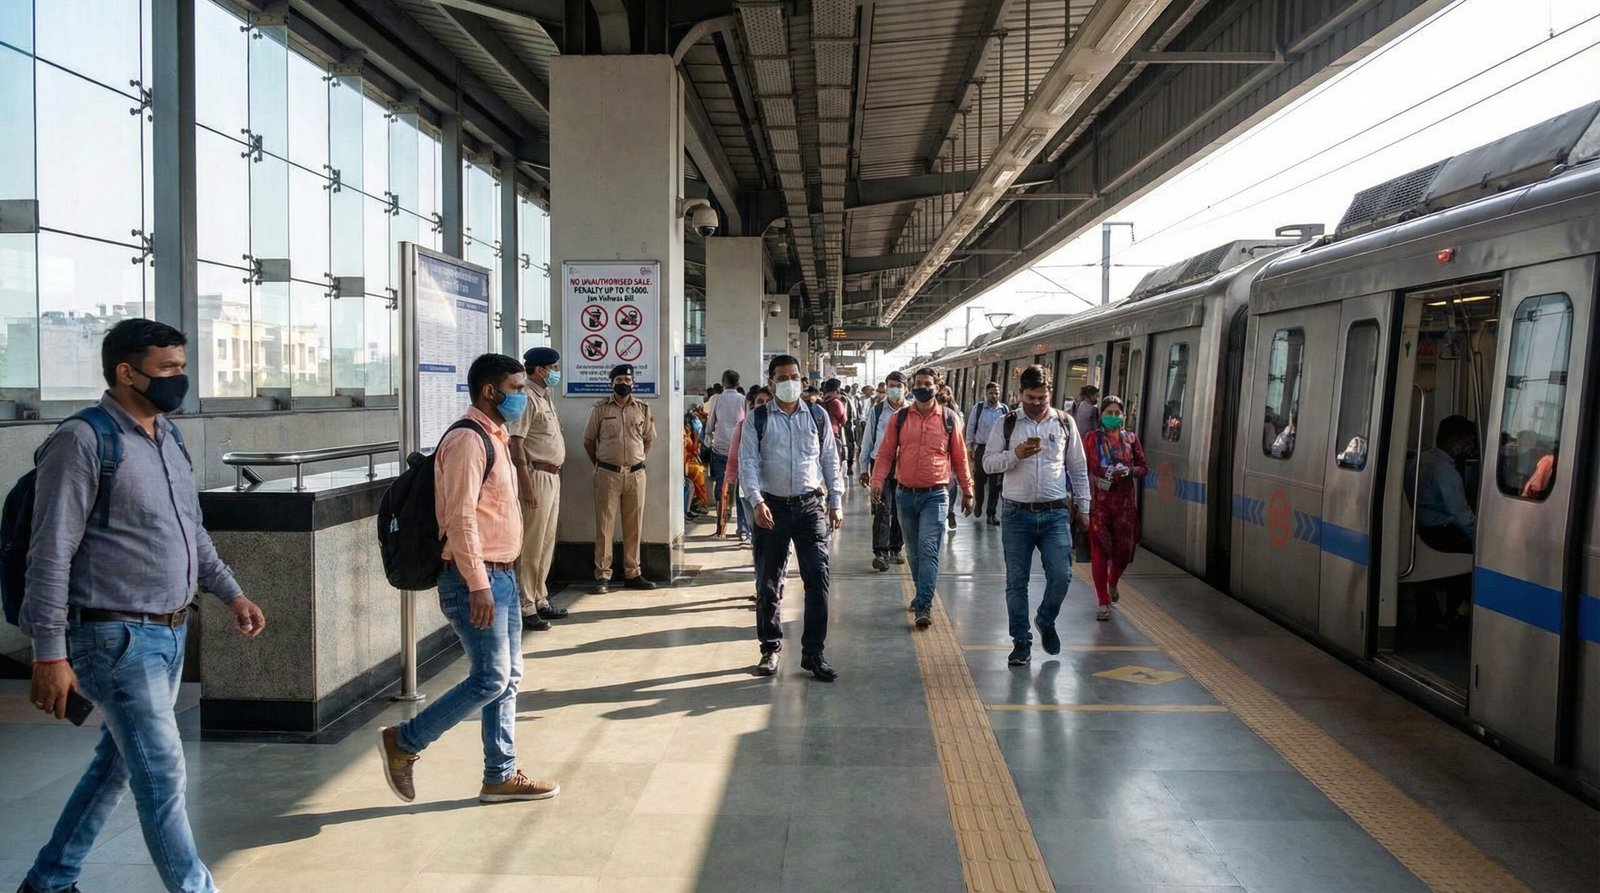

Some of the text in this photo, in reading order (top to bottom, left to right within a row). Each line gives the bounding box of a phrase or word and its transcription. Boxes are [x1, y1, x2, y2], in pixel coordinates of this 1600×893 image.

[570, 278, 580, 286] NO
[581, 278, 633, 286] UNAUTHORISED
[574, 286, 603, 294] PENALTY
[604, 286, 613, 294] UP
[615, 286, 624, 294] TO
[587, 295, 597, 303] Jan
